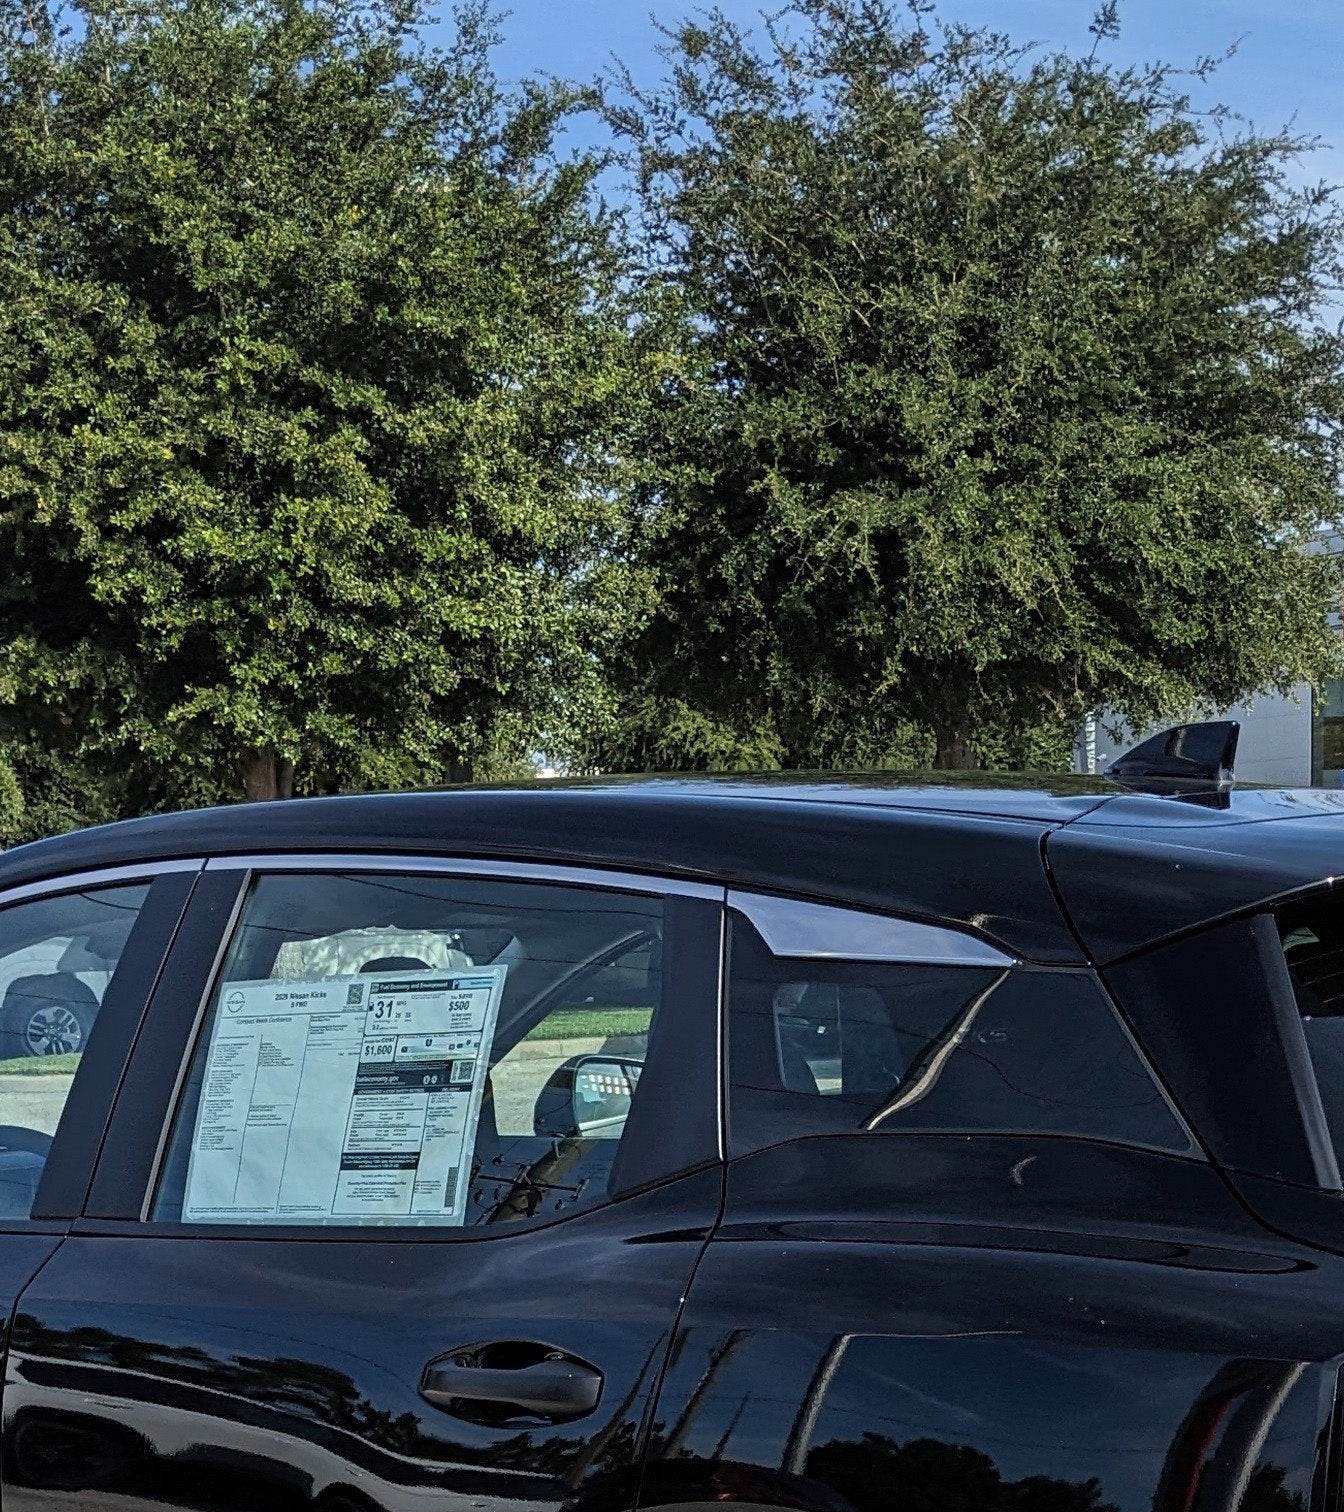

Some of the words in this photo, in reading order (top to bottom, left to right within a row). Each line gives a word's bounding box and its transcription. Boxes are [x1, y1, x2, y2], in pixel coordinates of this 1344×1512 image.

[375, 1000, 394, 1019] 31
[448, 1000, 470, 1012] $500
[365, 1044, 393, 1057] $1,600
